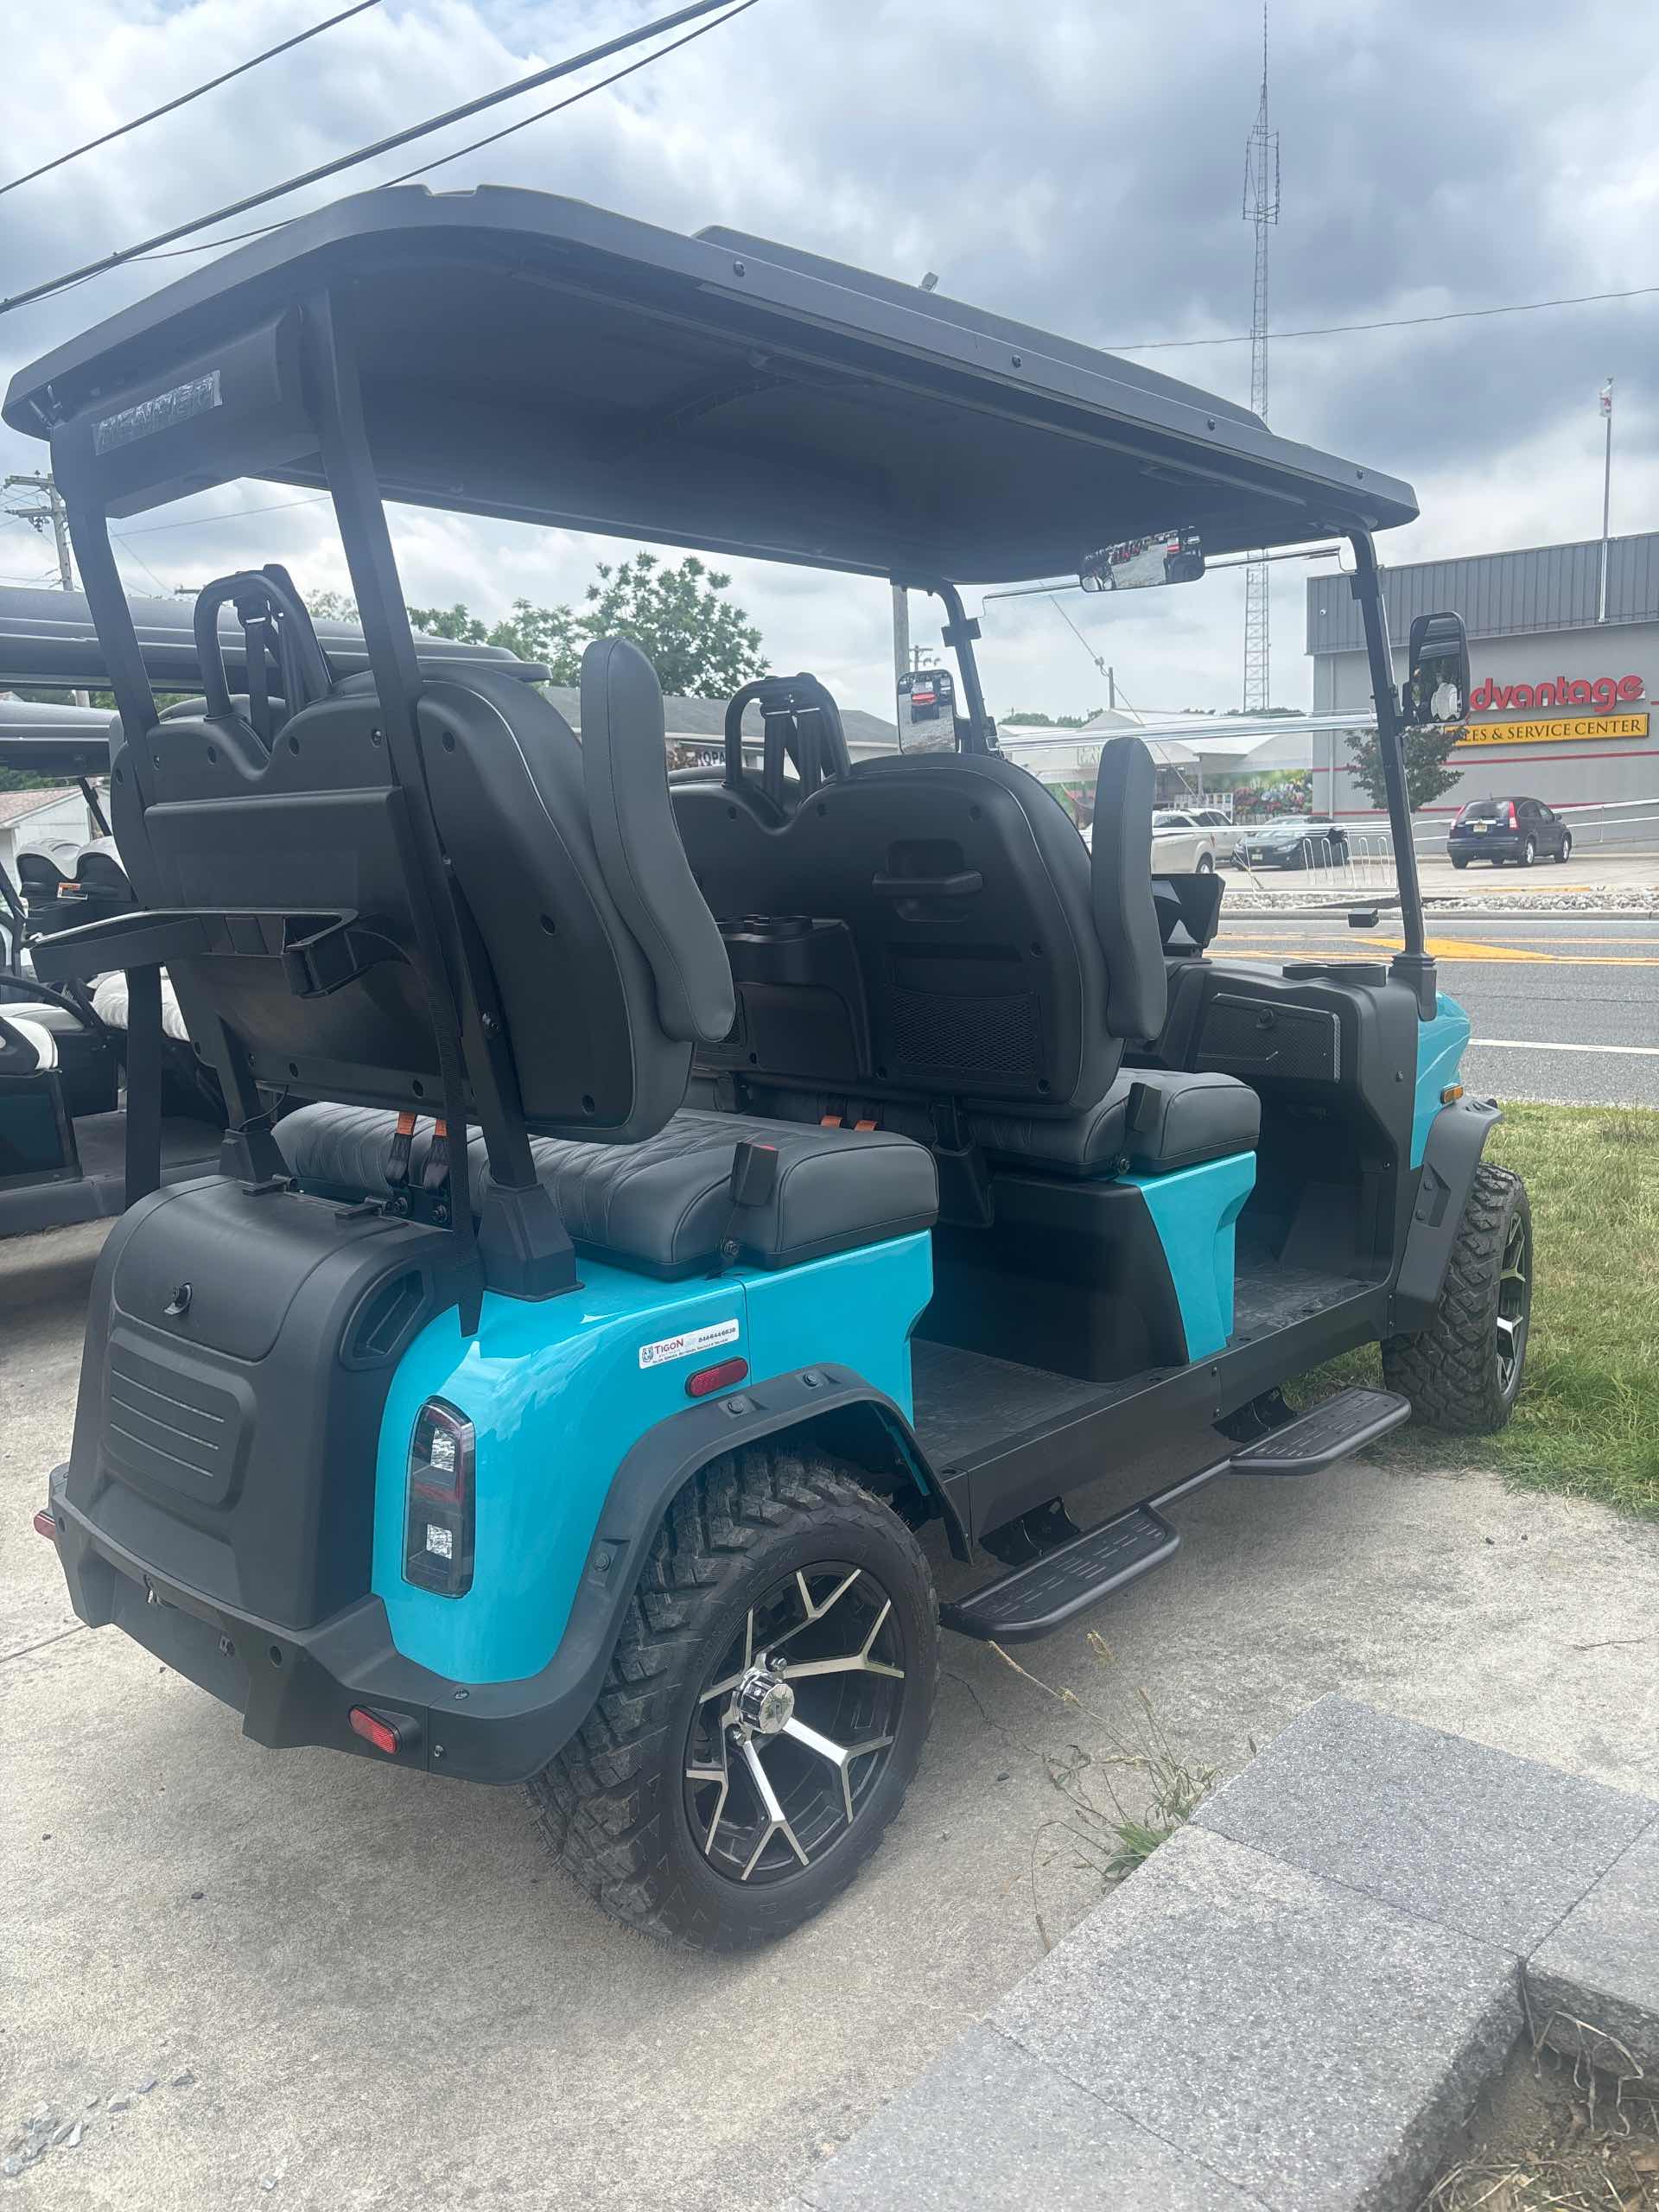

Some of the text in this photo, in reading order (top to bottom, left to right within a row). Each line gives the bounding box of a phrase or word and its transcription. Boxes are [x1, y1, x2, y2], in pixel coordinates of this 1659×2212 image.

[1469, 675, 1644, 713] dvantage
[1464, 720, 1641, 742] LES & SERVICE CENTER
[654, 1338, 684, 1354] TIGON
